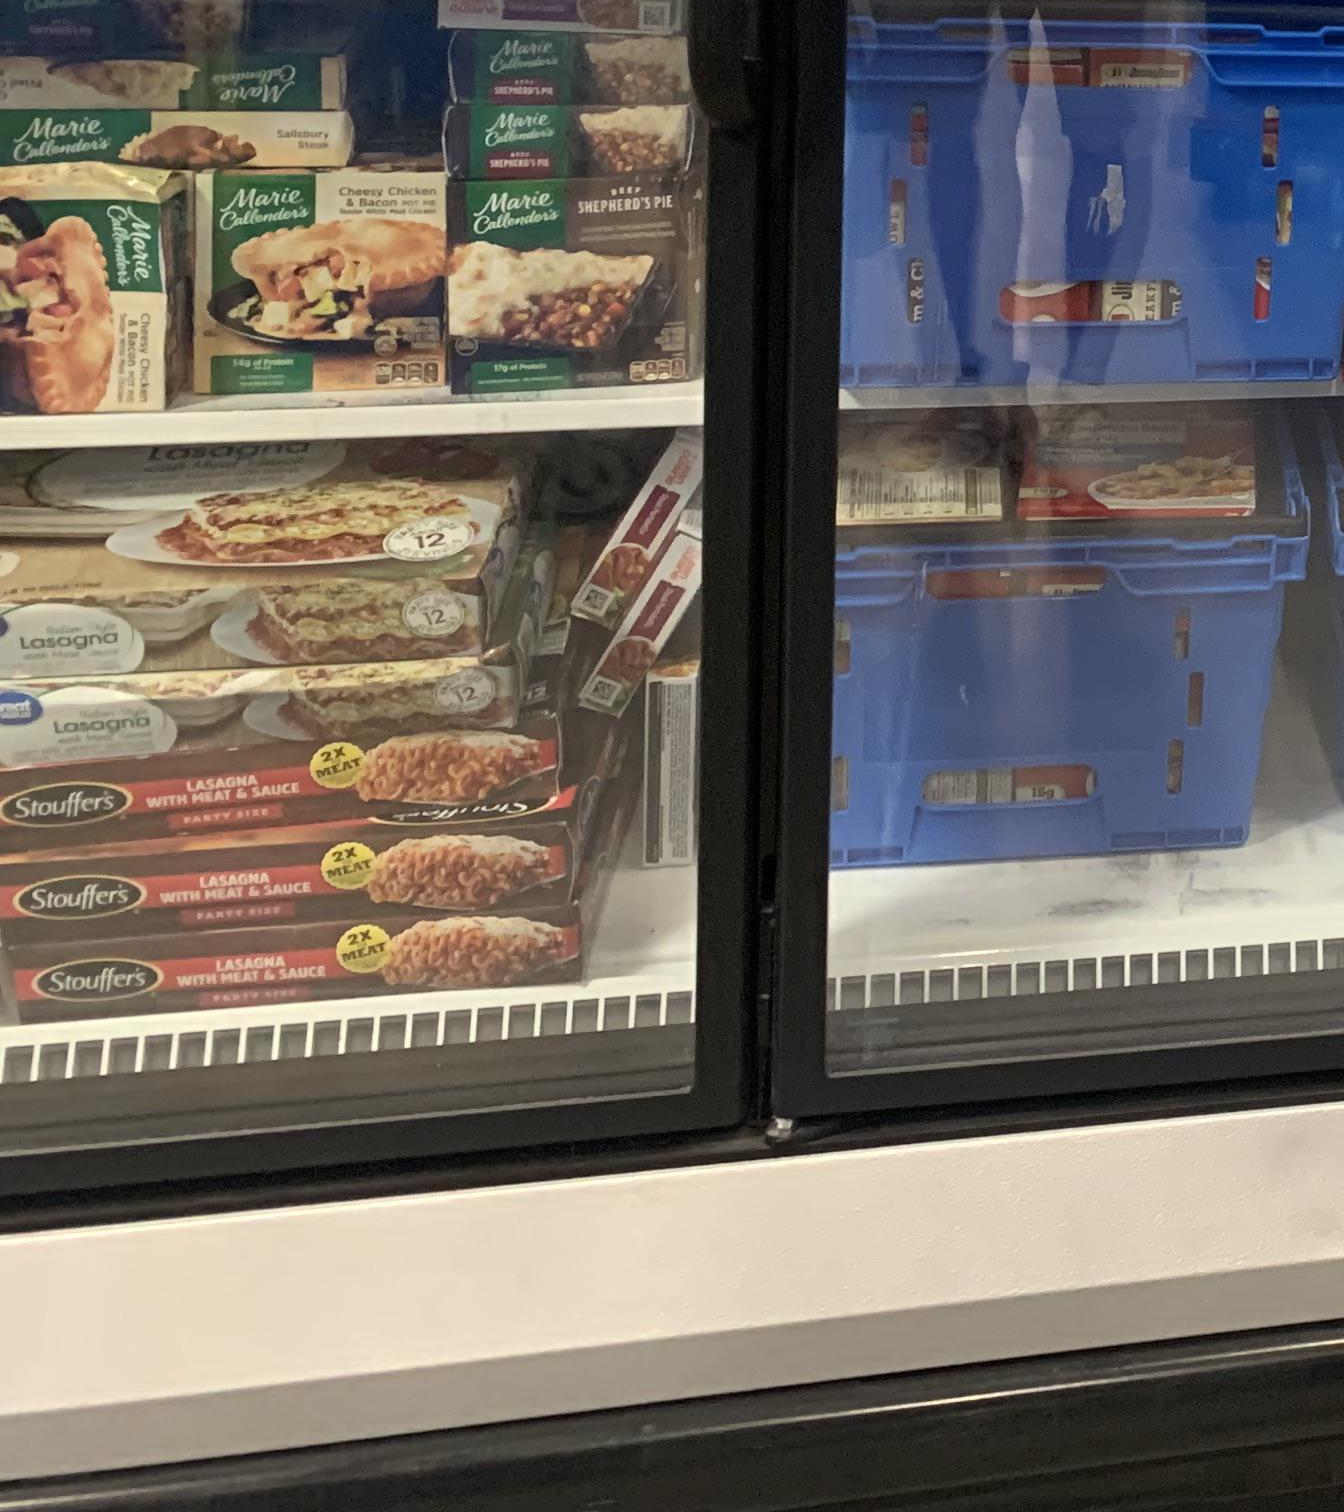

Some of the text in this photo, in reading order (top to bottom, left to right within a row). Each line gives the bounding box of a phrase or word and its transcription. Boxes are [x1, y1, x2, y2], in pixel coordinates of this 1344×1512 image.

[13, 117, 104, 142] Marie
[488, 111, 551, 132] Marie
[13, 137, 112, 162] Callender's
[220, 187, 304, 212] Marie
[339, 187, 437, 198] Cheesy Chicken
[475, 190, 554, 217] Marie
[578, 196, 673, 214] SHEPHERD'S PIE
[220, 206, 310, 230] Callender's
[473, 211, 559, 236] Callender's
[106, 204, 130, 287] Callender's
[128, 205, 152, 283] Marie
[413, 531, 447, 549] 12
[19, 630, 118, 652] Lasagna
[52, 714, 152, 735] Lasagna
[320, 747, 347, 764] 2X
[316, 759, 365, 780] MEAT
[146, 781, 300, 809] WITH MEAT & SAUCE
[186, 775, 258, 794] LASAGNA
[14, 789, 115, 820] Stouffer's
[331, 848, 358, 864] 2X
[326, 859, 372, 877] MEAT
[199, 872, 270, 888] LASAGNA
[30, 882, 128, 911] Stouffer's
[160, 888, 201, 904] WITH
[206, 886, 245, 901] MEAT
[263, 881, 311, 896] SAUCE
[346, 930, 373, 947] 2X
[341, 943, 387, 961] MEAT
[215, 956, 286, 971] LASAGNA
[48, 965, 146, 994] Stouffer's
[176, 972, 218, 987] WITH
[222, 970, 261, 985] MEAT
[279, 966, 326, 979] SAUCE
